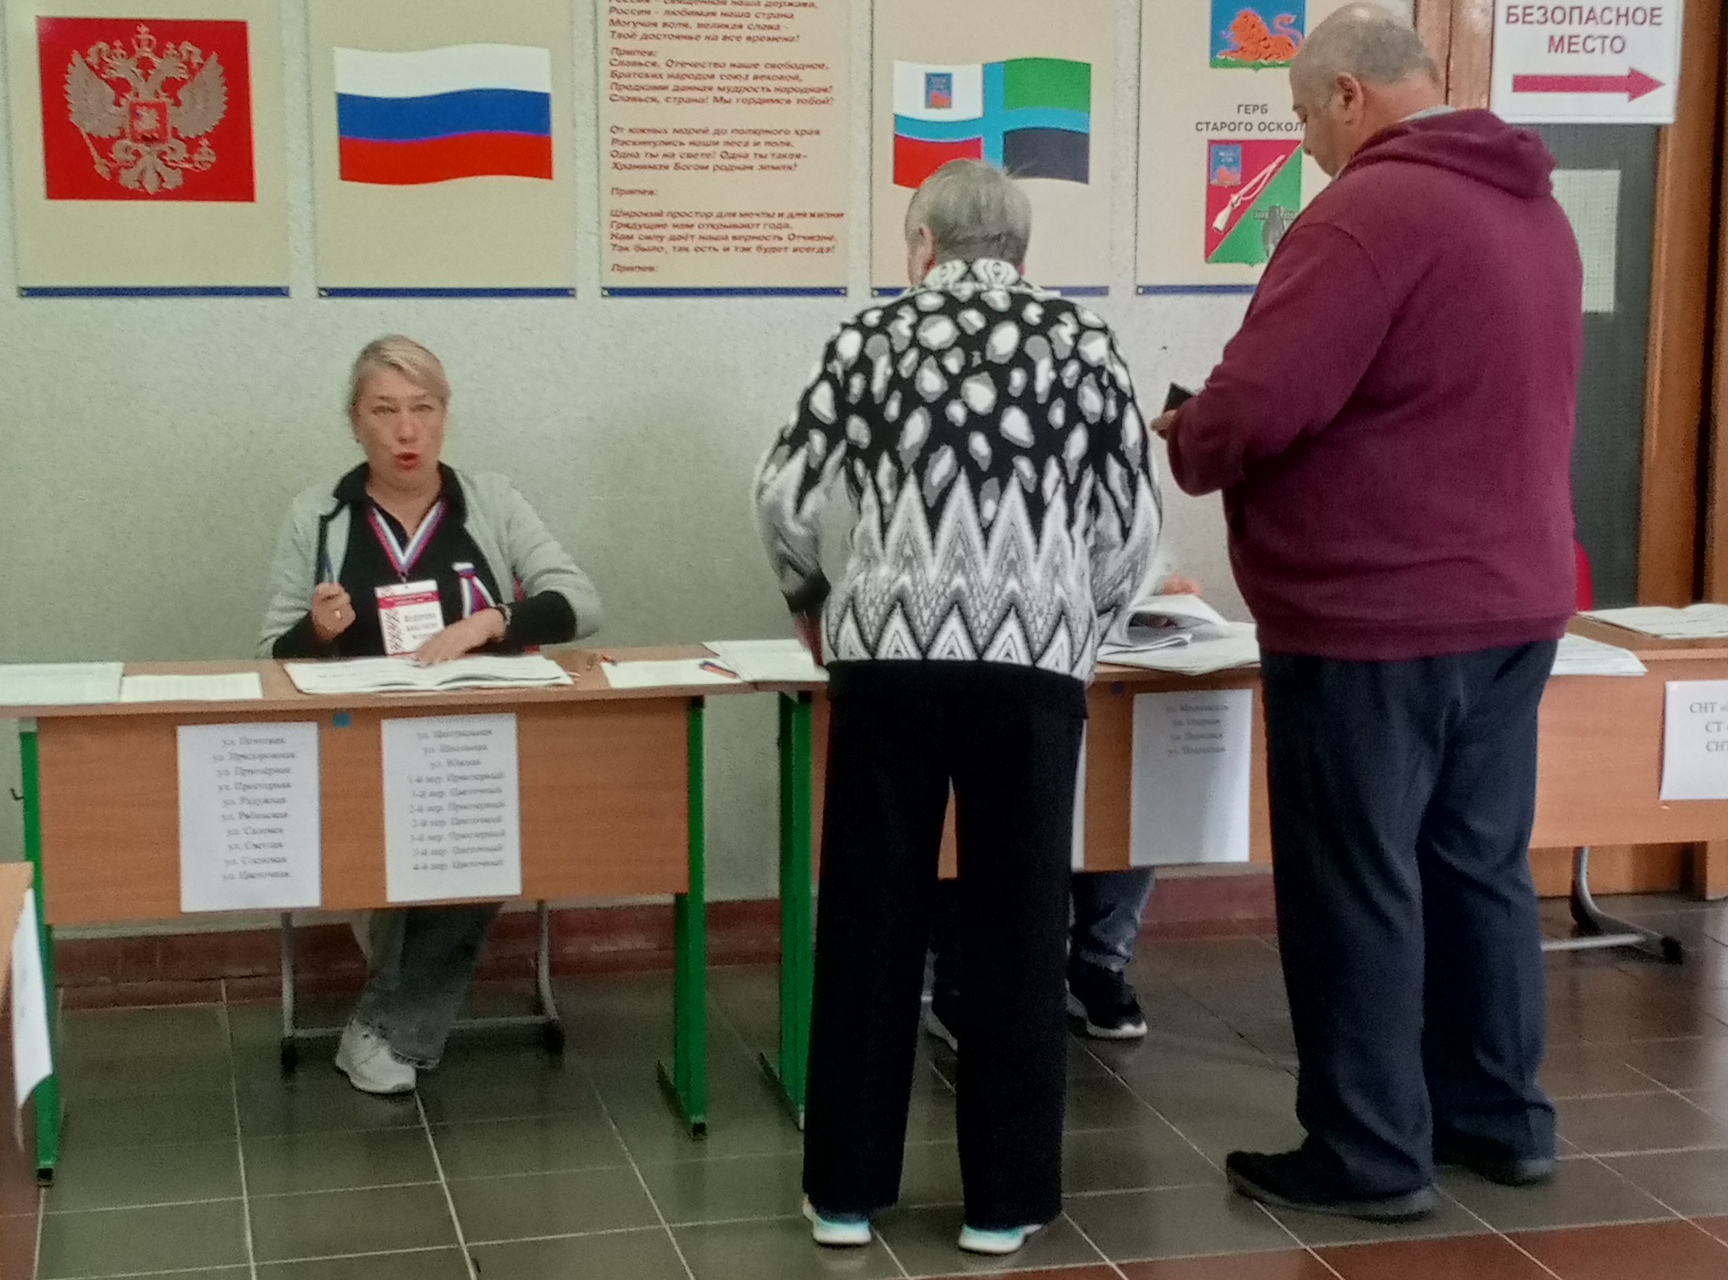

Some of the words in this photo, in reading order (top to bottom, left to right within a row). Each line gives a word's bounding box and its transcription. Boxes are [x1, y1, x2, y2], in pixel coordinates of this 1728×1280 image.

[1505, 4, 1663, 27] БЕЗОПАСНОЕ
[1547, 34, 1626, 55] МЕСТО
[1237, 104, 1268, 115] ГЕРБ
[1195, 121, 1253, 132] СТАРОГО
[1258, 121, 1305, 132] ОСКОЛ
